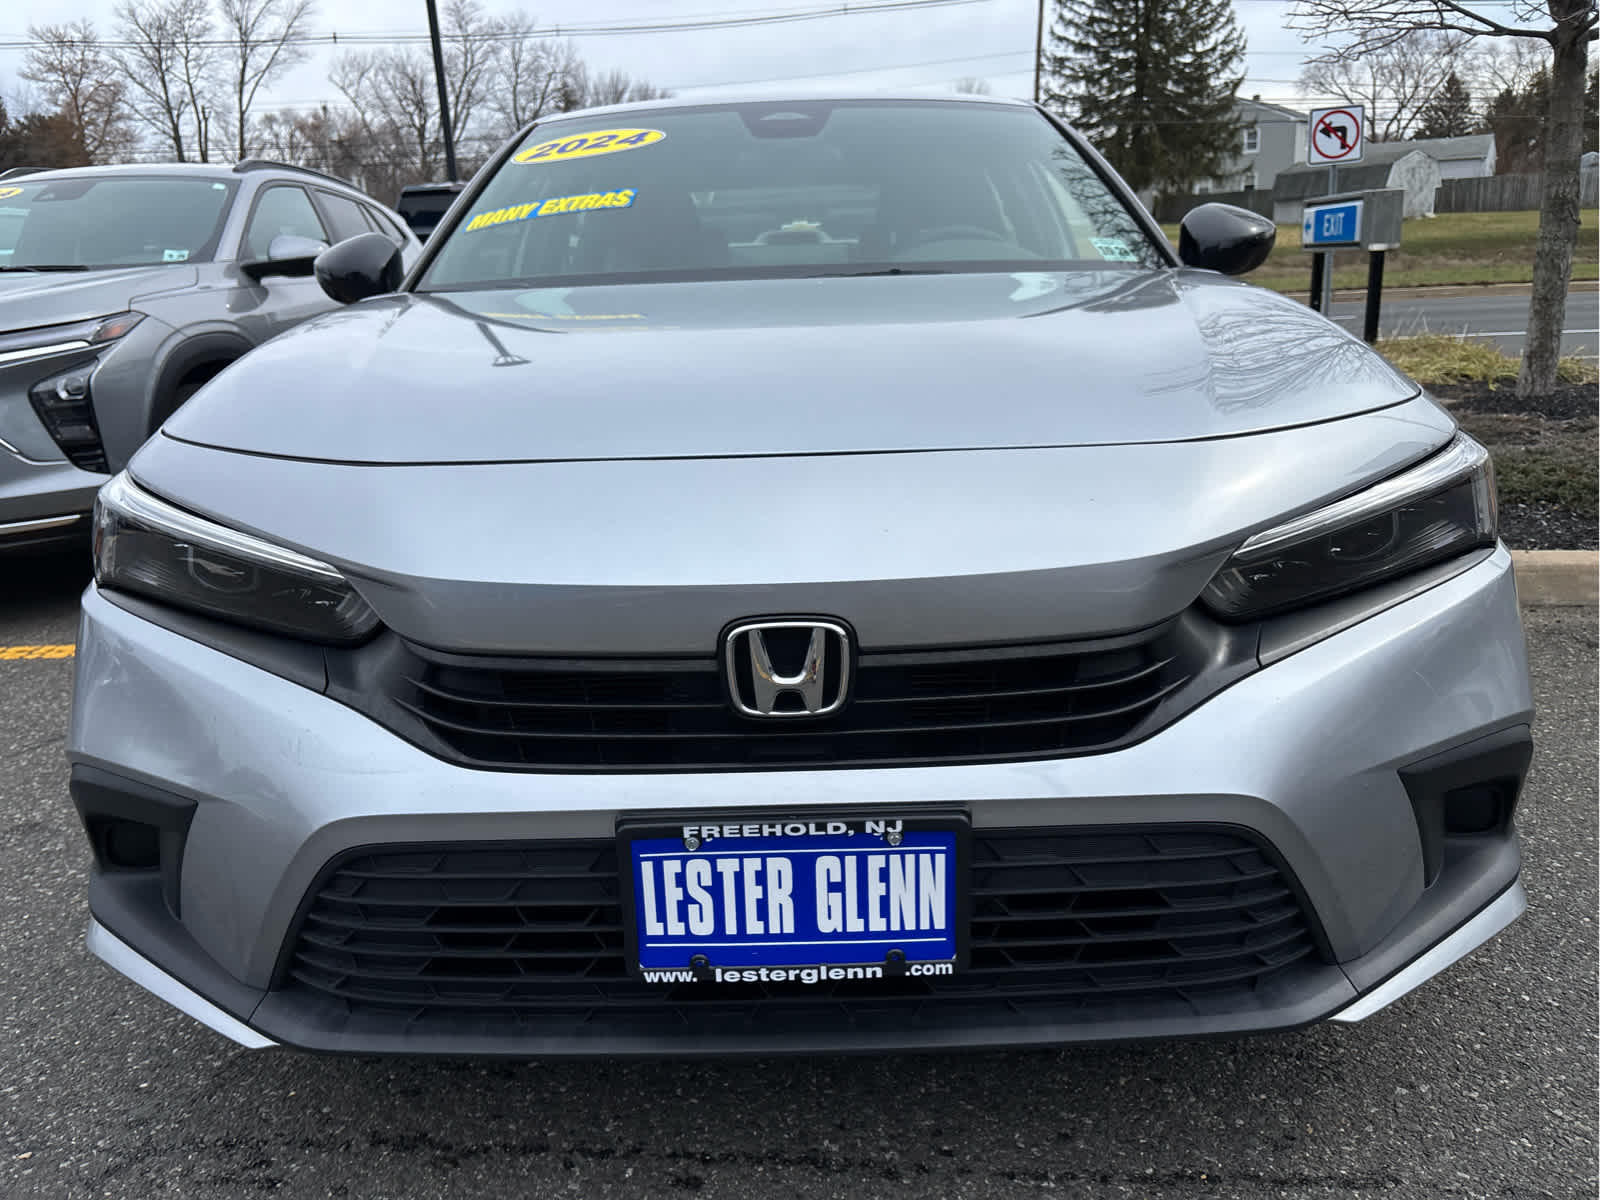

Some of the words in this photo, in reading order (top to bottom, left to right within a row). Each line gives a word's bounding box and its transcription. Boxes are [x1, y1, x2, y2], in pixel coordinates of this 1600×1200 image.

[525, 131, 650, 161] 2024
[466, 202, 541, 232] MANY
[1323, 212, 1345, 237] EXIT
[683, 822, 855, 839] FREEHOLD,
[865, 820, 903, 836] NJ
[641, 857, 795, 936] LESTER
[815, 853, 946, 933] GLENN
[644, 971, 698, 984] www.
[715, 965, 882, 984] lesterglenn
[904, 961, 953, 977] .com
